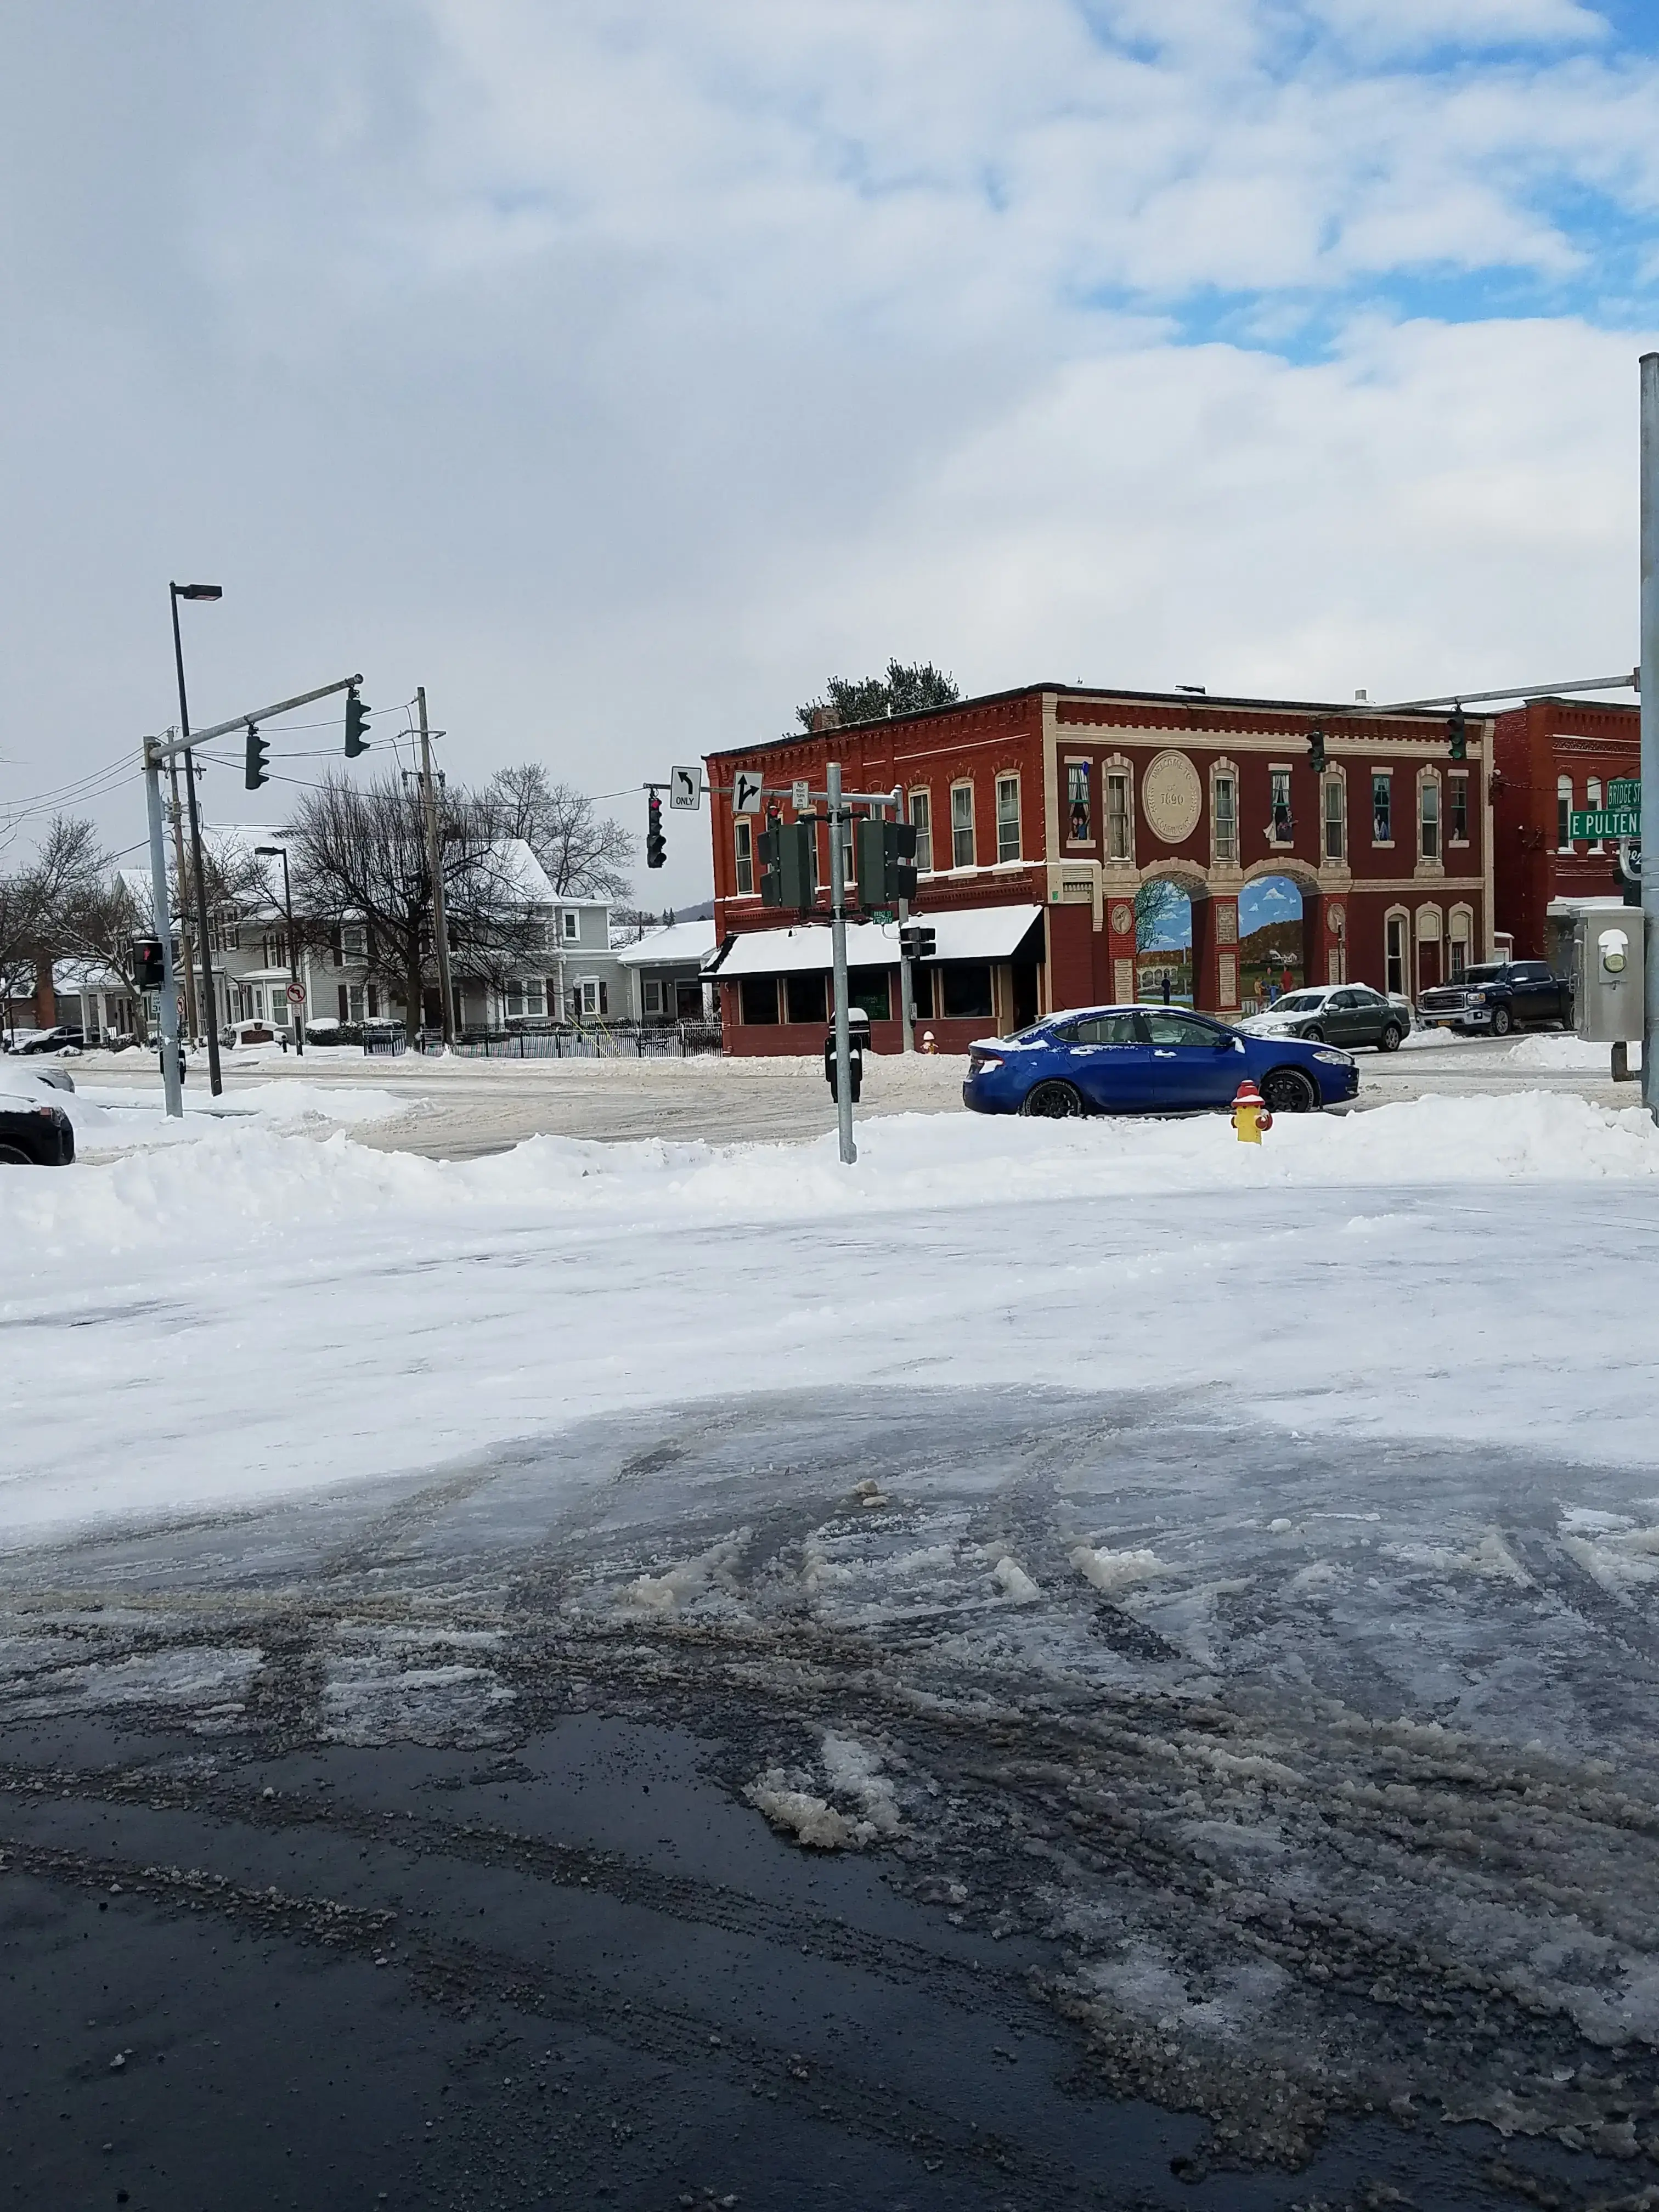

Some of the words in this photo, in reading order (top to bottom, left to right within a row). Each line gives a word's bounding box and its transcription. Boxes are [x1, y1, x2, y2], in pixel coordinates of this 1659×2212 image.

[1152, 758, 1183, 779] WELCOME
[1183, 767, 1192, 780] TO
[676, 797, 695, 806] ONLY
[1160, 793, 1184, 805] 1890
[1608, 783, 1632, 805] BRIDGE
[1573, 815, 1580, 835] E
[1586, 813, 1641, 834] PULTEN
